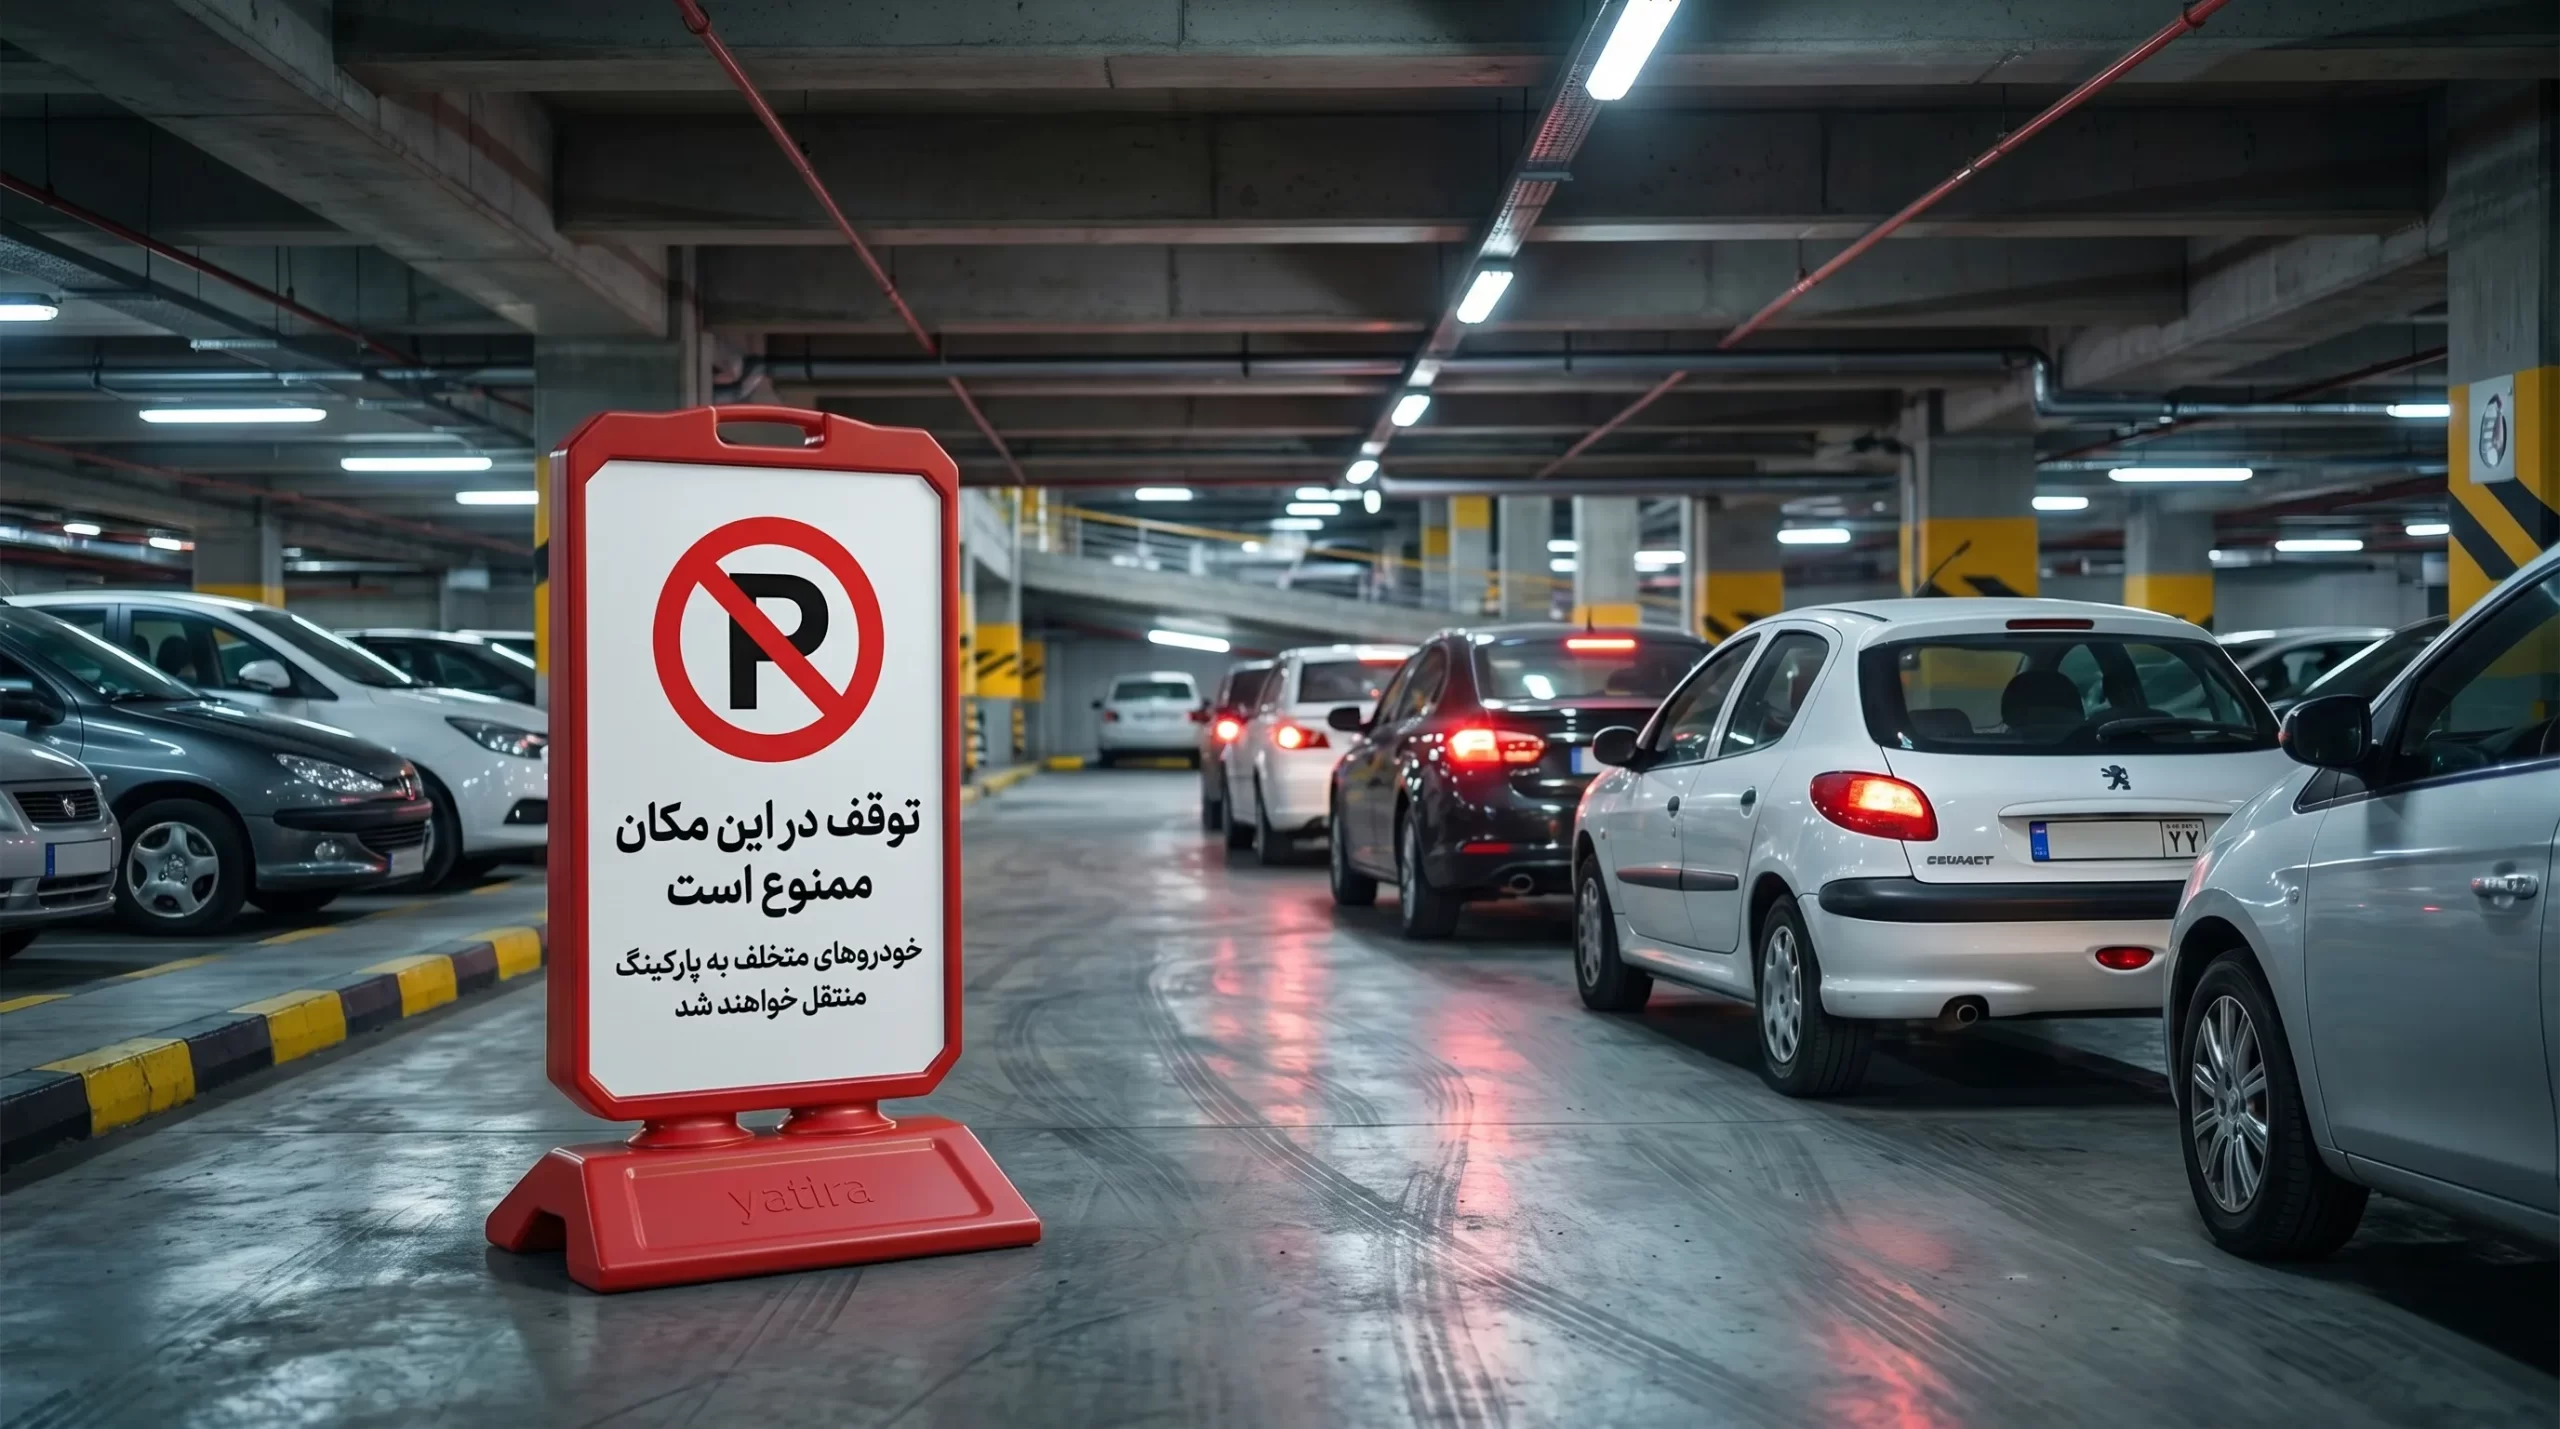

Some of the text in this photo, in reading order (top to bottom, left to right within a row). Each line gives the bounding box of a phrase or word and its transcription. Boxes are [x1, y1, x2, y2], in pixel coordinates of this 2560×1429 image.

[729, 573, 829, 710] P
[616, 791, 921, 854] توقف در این مکان
[667, 864, 873, 918] ممنوع است
[615, 938, 923, 984] خودروهای متخلف به پارکینگ
[675, 984, 867, 1020] منتقل خواهند شد
[727, 1175, 875, 1226] yatira
